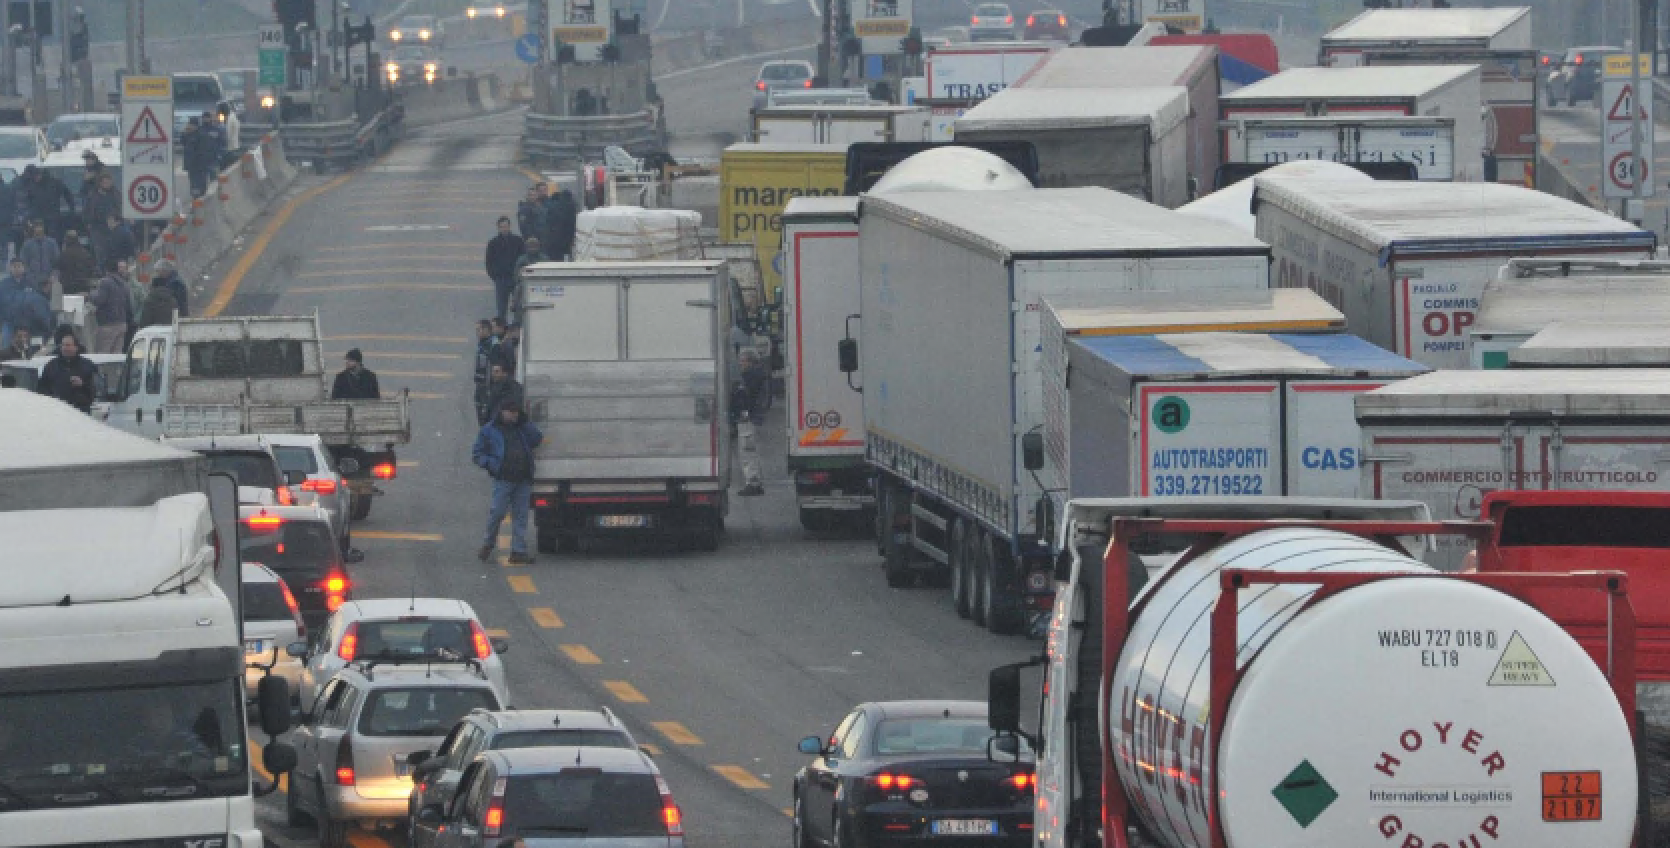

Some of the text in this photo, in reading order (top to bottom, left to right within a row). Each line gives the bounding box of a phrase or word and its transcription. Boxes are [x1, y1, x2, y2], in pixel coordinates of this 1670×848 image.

[137, 185, 159, 205] 30
[1423, 298, 1479, 309] COMMIS
[1422, 311, 1475, 337] OP
[1423, 341, 1465, 352] POMPEI
[1159, 401, 1182, 427] a
[1153, 447, 1269, 470] AUTOTRASPORTI
[1154, 474, 1264, 496] 339.2719522
[1402, 470, 1503, 484] COMMERCIO
[1377, 629, 1421, 648] WABU
[1425, 629, 1452, 648] 727
[1456, 629, 1483, 648] 018
[1374, 720, 1506, 778] HOYER
[1369, 789, 1513, 805] International Logistics
[1378, 813, 1500, 848] GRUP
